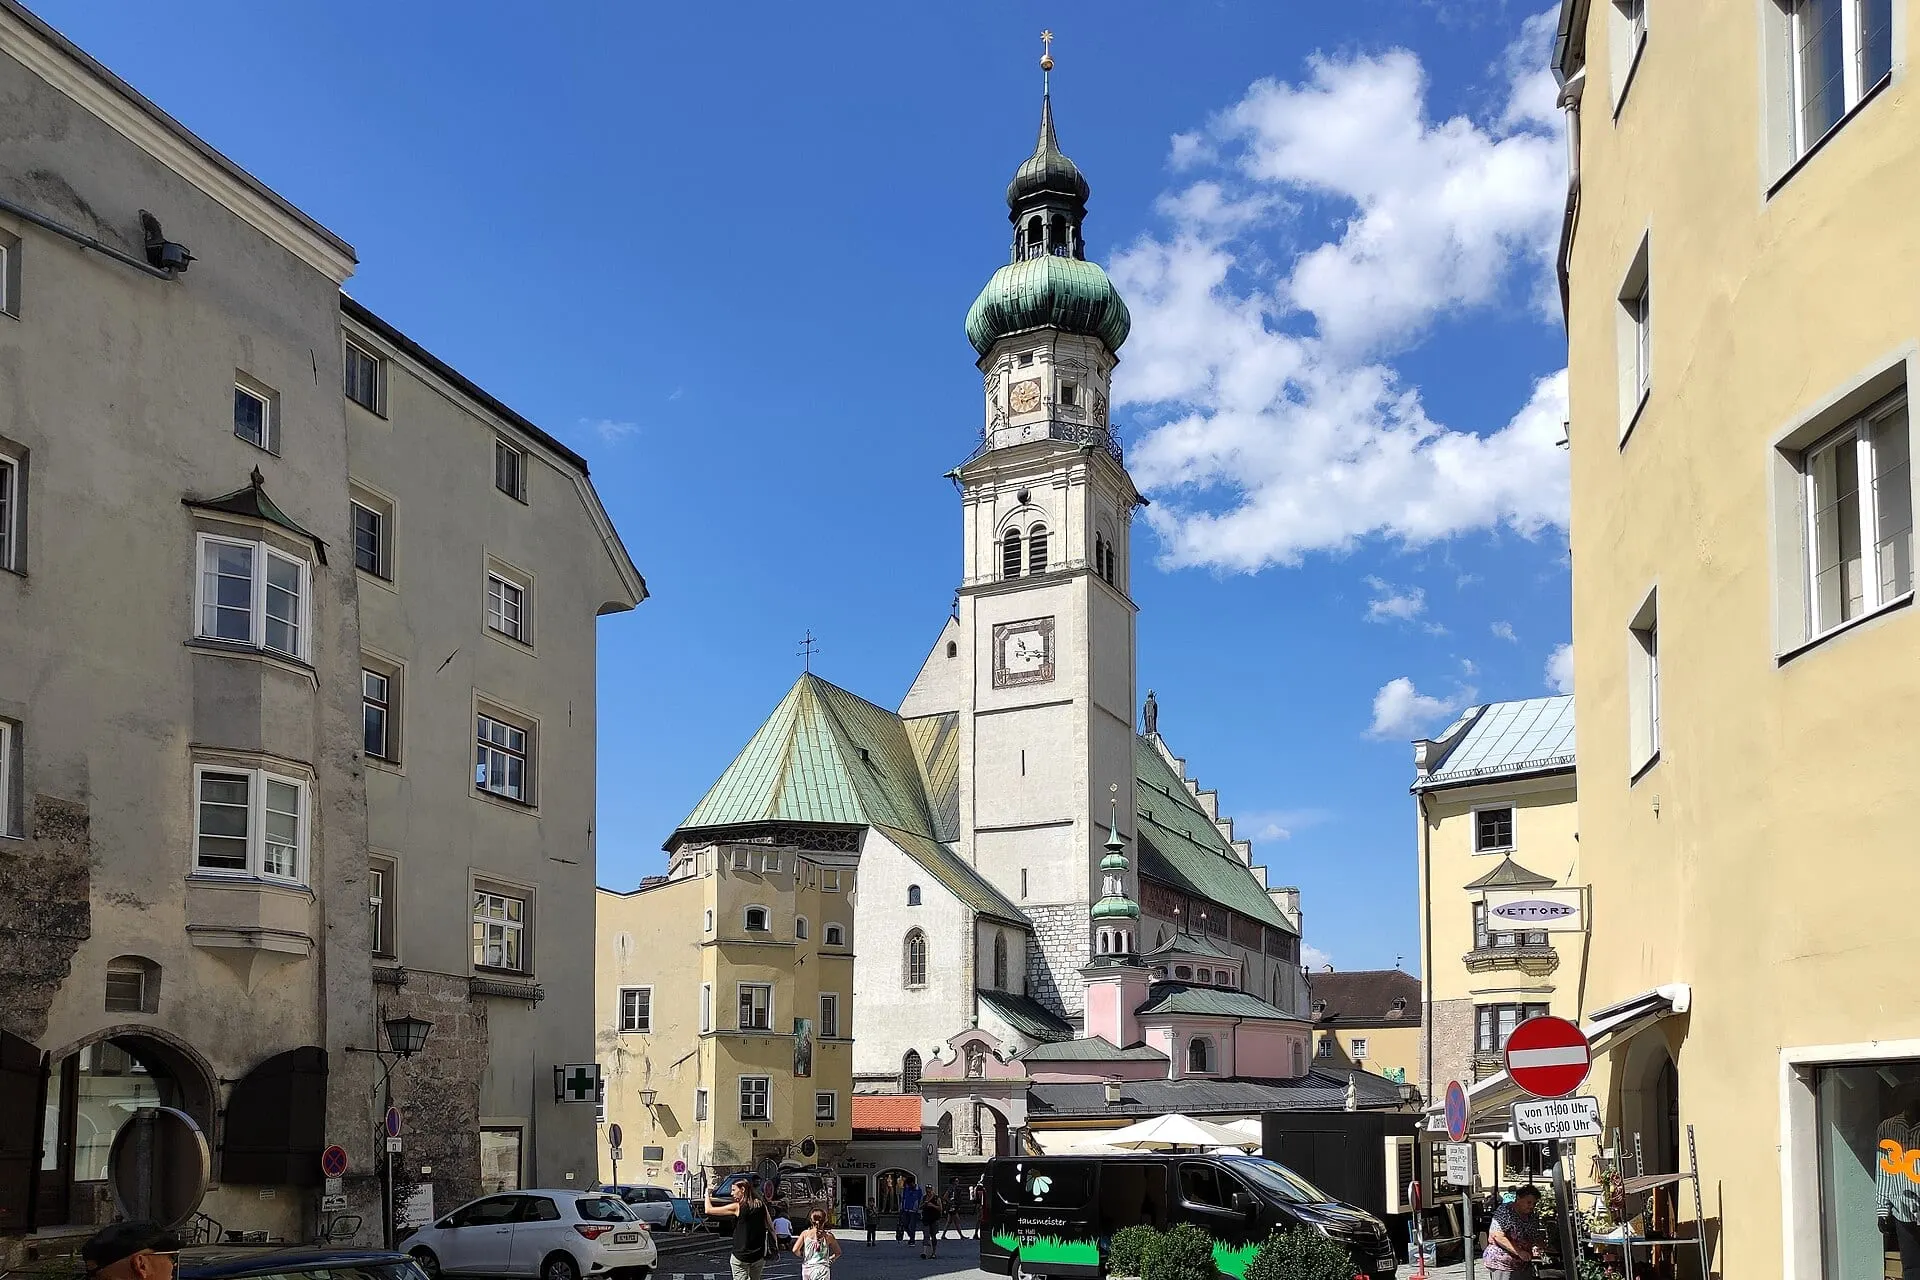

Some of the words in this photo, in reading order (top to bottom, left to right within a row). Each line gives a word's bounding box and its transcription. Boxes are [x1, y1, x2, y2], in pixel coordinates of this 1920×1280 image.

[1496, 907, 1570, 916] VETTORI
[1524, 1108, 1542, 1118] von
[1545, 1104, 1569, 1116] 11:00
[1571, 1102, 1589, 1114] Uhr
[1528, 1123, 1543, 1135] bis
[1545, 1121, 1571, 1133] 05:00
[1573, 1120, 1591, 1131] Uhr
